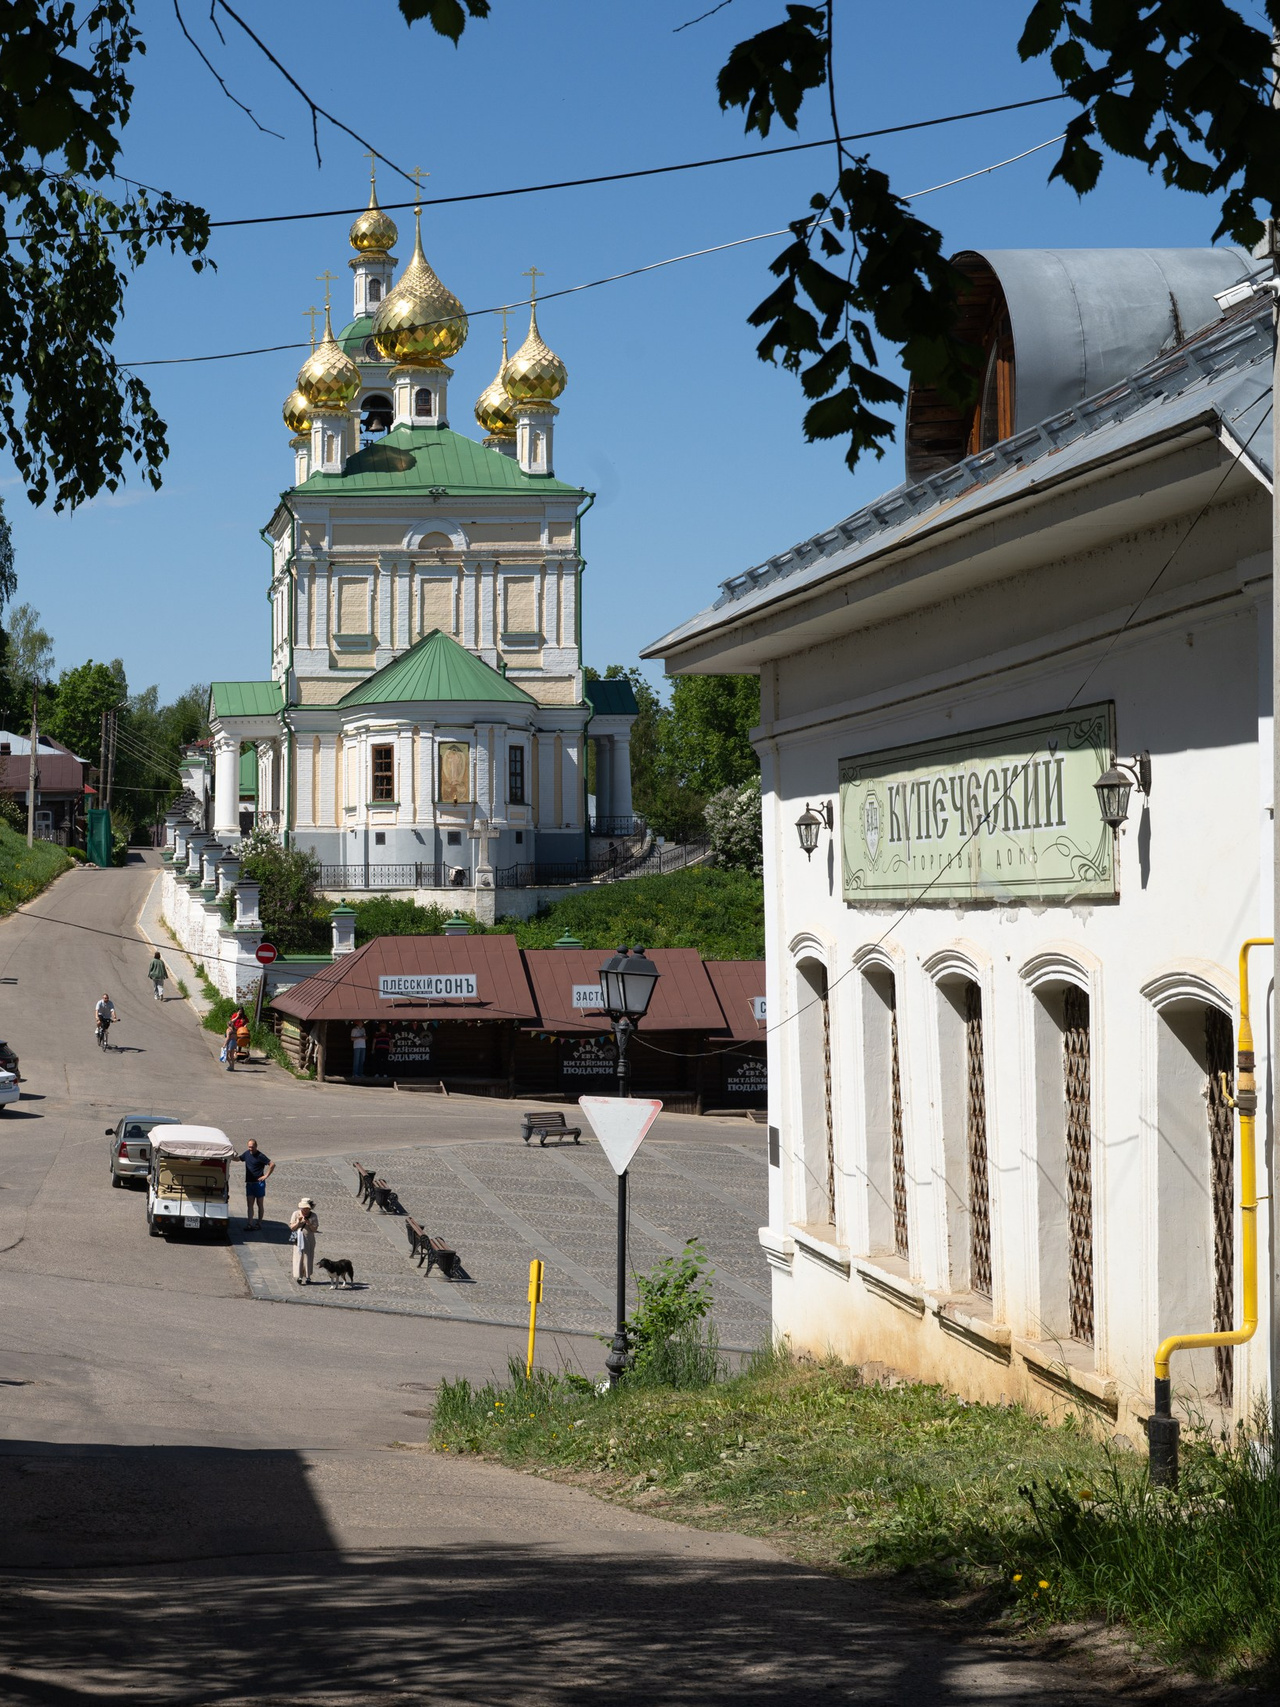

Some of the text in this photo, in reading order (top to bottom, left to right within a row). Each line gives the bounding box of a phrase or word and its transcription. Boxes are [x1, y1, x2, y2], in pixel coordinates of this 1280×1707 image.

[887, 740, 1066, 861] КУПЕЧЕСКИЙ
[434, 978, 474, 994] СОНЪ
[392, 1031, 421, 1046] АВКА
[387, 1053, 430, 1062] ОДАРКИ
[573, 1044, 605, 1059] ЛАВКА
[563, 1067, 614, 1075] ПОДАРКИ
